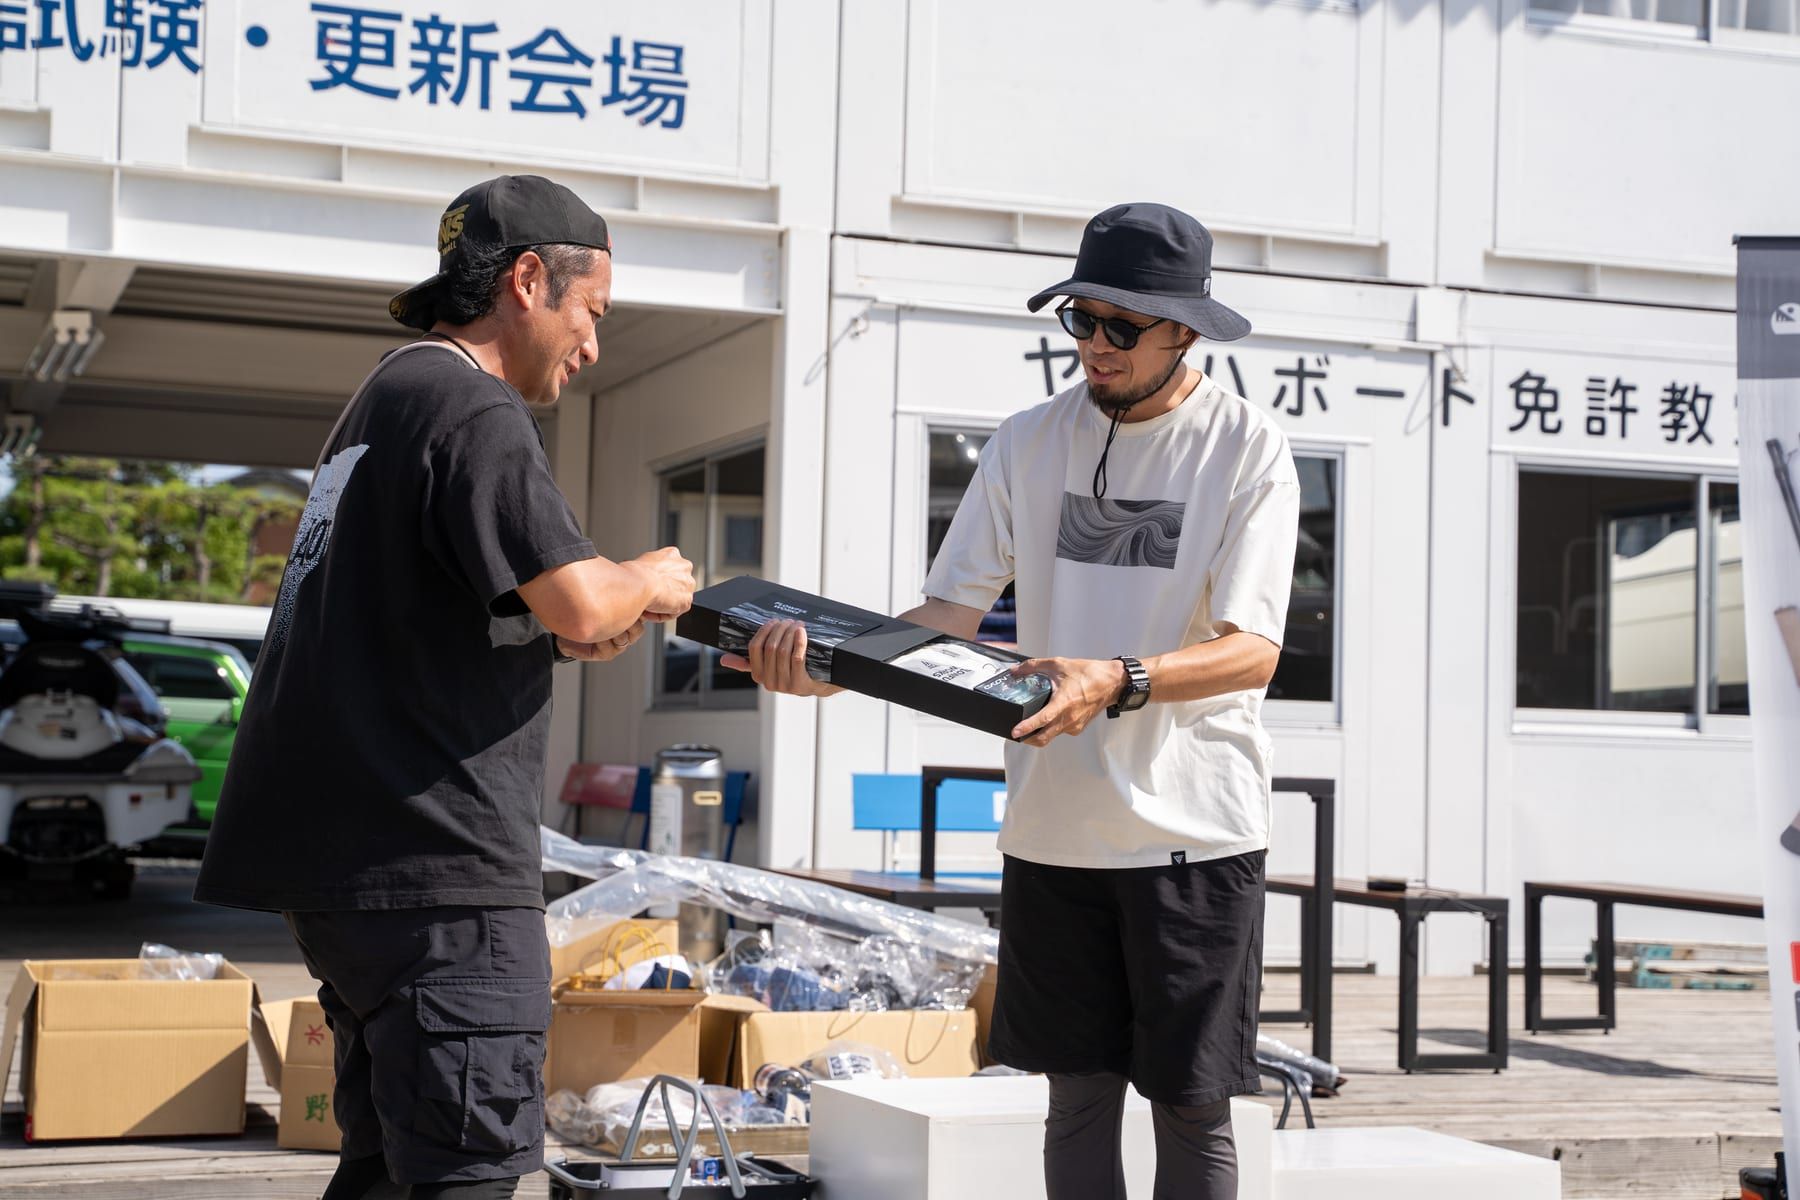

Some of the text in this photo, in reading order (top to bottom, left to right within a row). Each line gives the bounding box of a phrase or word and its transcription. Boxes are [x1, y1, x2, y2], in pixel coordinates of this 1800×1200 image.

[1024, 336, 1738, 445] ヤハボート免許教
